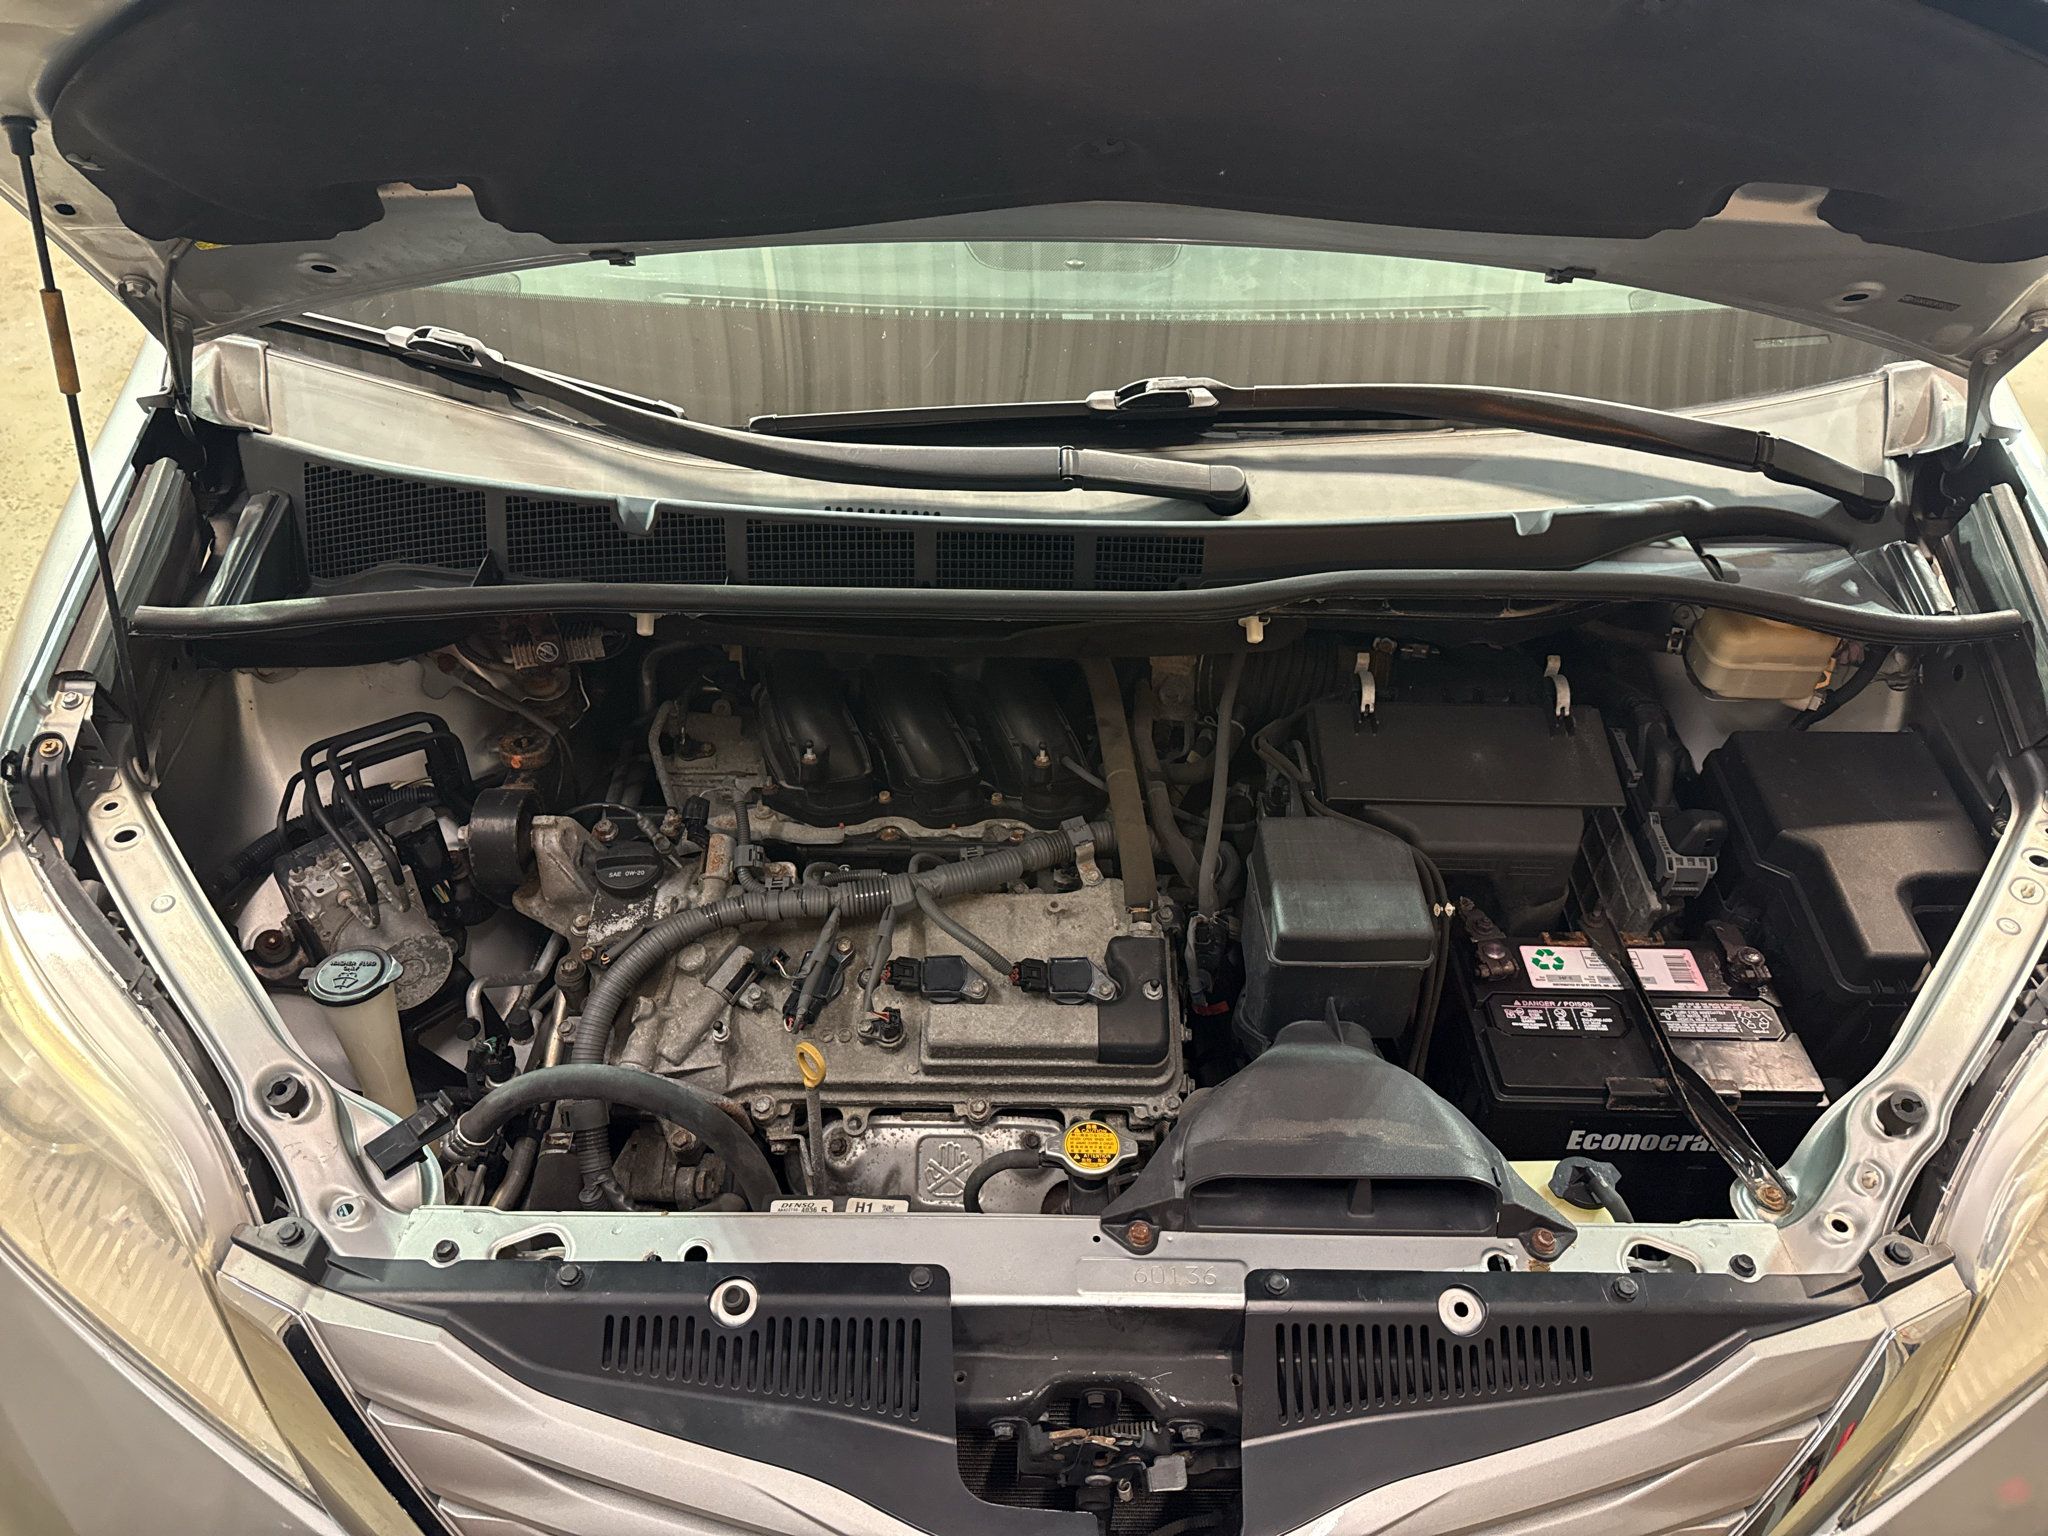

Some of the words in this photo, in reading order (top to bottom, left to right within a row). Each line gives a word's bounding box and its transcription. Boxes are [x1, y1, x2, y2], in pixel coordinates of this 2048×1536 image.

[1566, 1130, 1715, 1152] Econocra
[855, 1202, 873, 1213] H1
[1134, 1265, 1217, 1285] 60136
